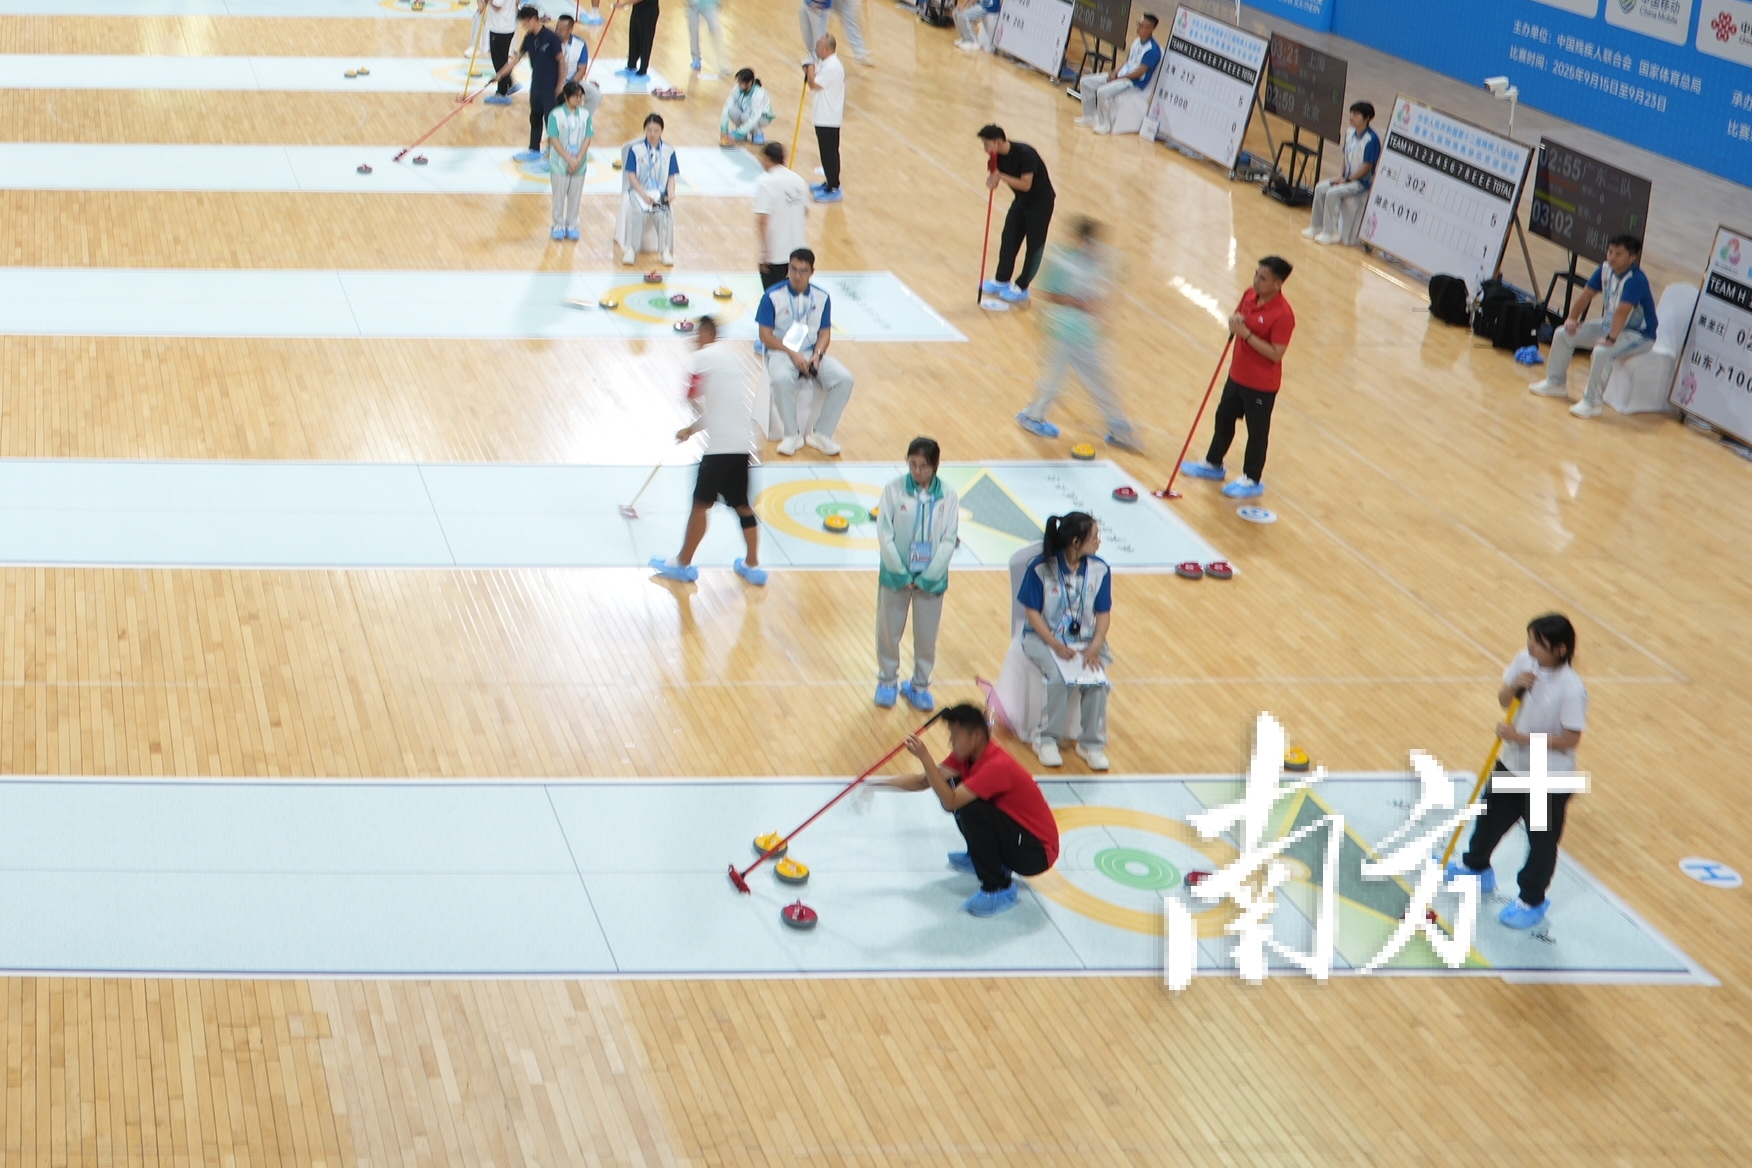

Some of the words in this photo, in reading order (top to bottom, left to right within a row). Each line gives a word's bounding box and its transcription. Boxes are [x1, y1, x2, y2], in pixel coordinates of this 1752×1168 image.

[1639, 5, 1657, 20] China
[1658, 9, 1678, 26] Mobile
[1557, 33, 1633, 72] 中国残疾人联合会
[1639, 59, 1702, 96] 国家体育总局
[1553, 60, 1667, 113] 2025年9月15日至9月23日
[1389, 134, 1406, 153] TEAM
[1493, 179, 1512, 200] TOTAL
[1540, 148, 1582, 181] 02:55
[1490, 213, 1497, 228] 5
[1532, 199, 1573, 239] 03:02
[1710, 276, 1736, 299] TEAM
[1737, 285, 1746, 303] H
[1698, 313, 1725, 337] 黑龙江
[1691, 350, 1713, 371] 山东
[1682, 863, 1737, 882] H
